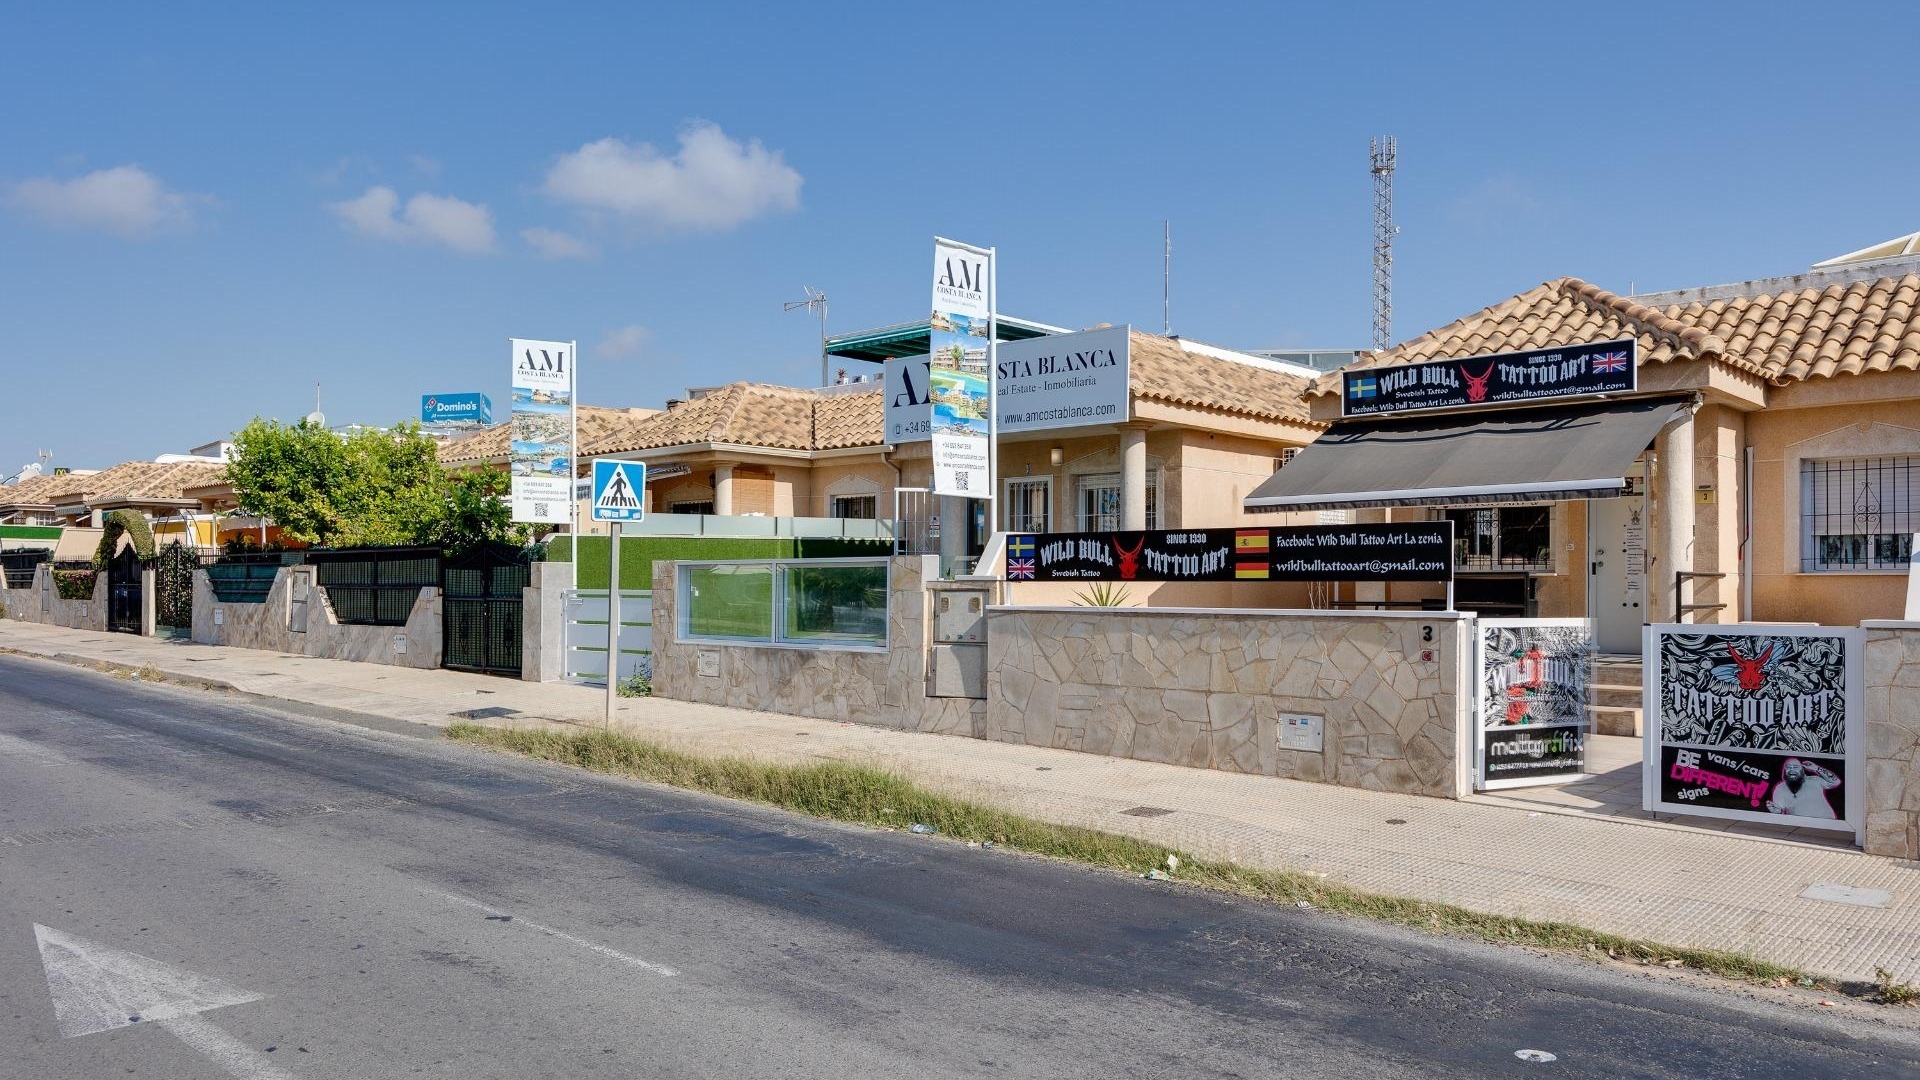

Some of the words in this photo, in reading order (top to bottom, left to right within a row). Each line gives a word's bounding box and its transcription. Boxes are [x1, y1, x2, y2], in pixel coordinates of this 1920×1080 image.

[938, 256, 982, 293] AM
[518, 348, 565, 373] AM
[996, 360, 1032, 380] STA
[1038, 349, 1117, 375] BLANCA
[1497, 362, 1558, 386] TATTOO
[1559, 354, 1590, 382] ART
[997, 385, 1009, 396] eal
[1011, 383, 1036, 395] Estate
[1044, 376, 1097, 391] Inmobiliaria
[1379, 367, 1418, 395] WILD
[1421, 365, 1460, 389] BULL
[1395, 389, 1425, 399] Swedish
[1492, 382, 1626, 401] wildbulltattooart@gmail.com
[437, 401, 477, 412] Domino's
[1004, 404, 1116, 424] www.amcostablanca.com
[1408, 401, 1427, 409] Tattoo
[1427, 399, 1438, 407] Art
[904, 421, 919, 434] +34
[1703, 492, 1708, 501] 3
[1166, 533, 1188, 544] SINCE
[1276, 533, 1315, 547] Facebook:
[1316, 533, 1338, 546] Wild
[1339, 532, 1357, 546] Bull
[1358, 533, 1386, 546] Tattoo
[1386, 532, 1403, 545] Art
[1404, 532, 1416, 544] La
[1418, 532, 1443, 544] zenia
[1040, 538, 1075, 567] WILD
[1078, 537, 1114, 567] BULL
[1144, 547, 1199, 577] TATTOO
[1201, 545, 1229, 575] ART
[1051, 568, 1079, 577] Swedish
[1080, 569, 1101, 577] Tattoo
[1276, 558, 1445, 574] wildbulltattooart@gmail.com
[1422, 625, 1433, 642] 3
[1668, 681, 1776, 729] TATTOO
[1781, 687, 1836, 729] ART
[1676, 749, 1702, 769] BE
[1707, 752, 1770, 780] vans/cars
[1670, 764, 1769, 807] DIFFERENT!
[1677, 787, 1710, 800] signs
